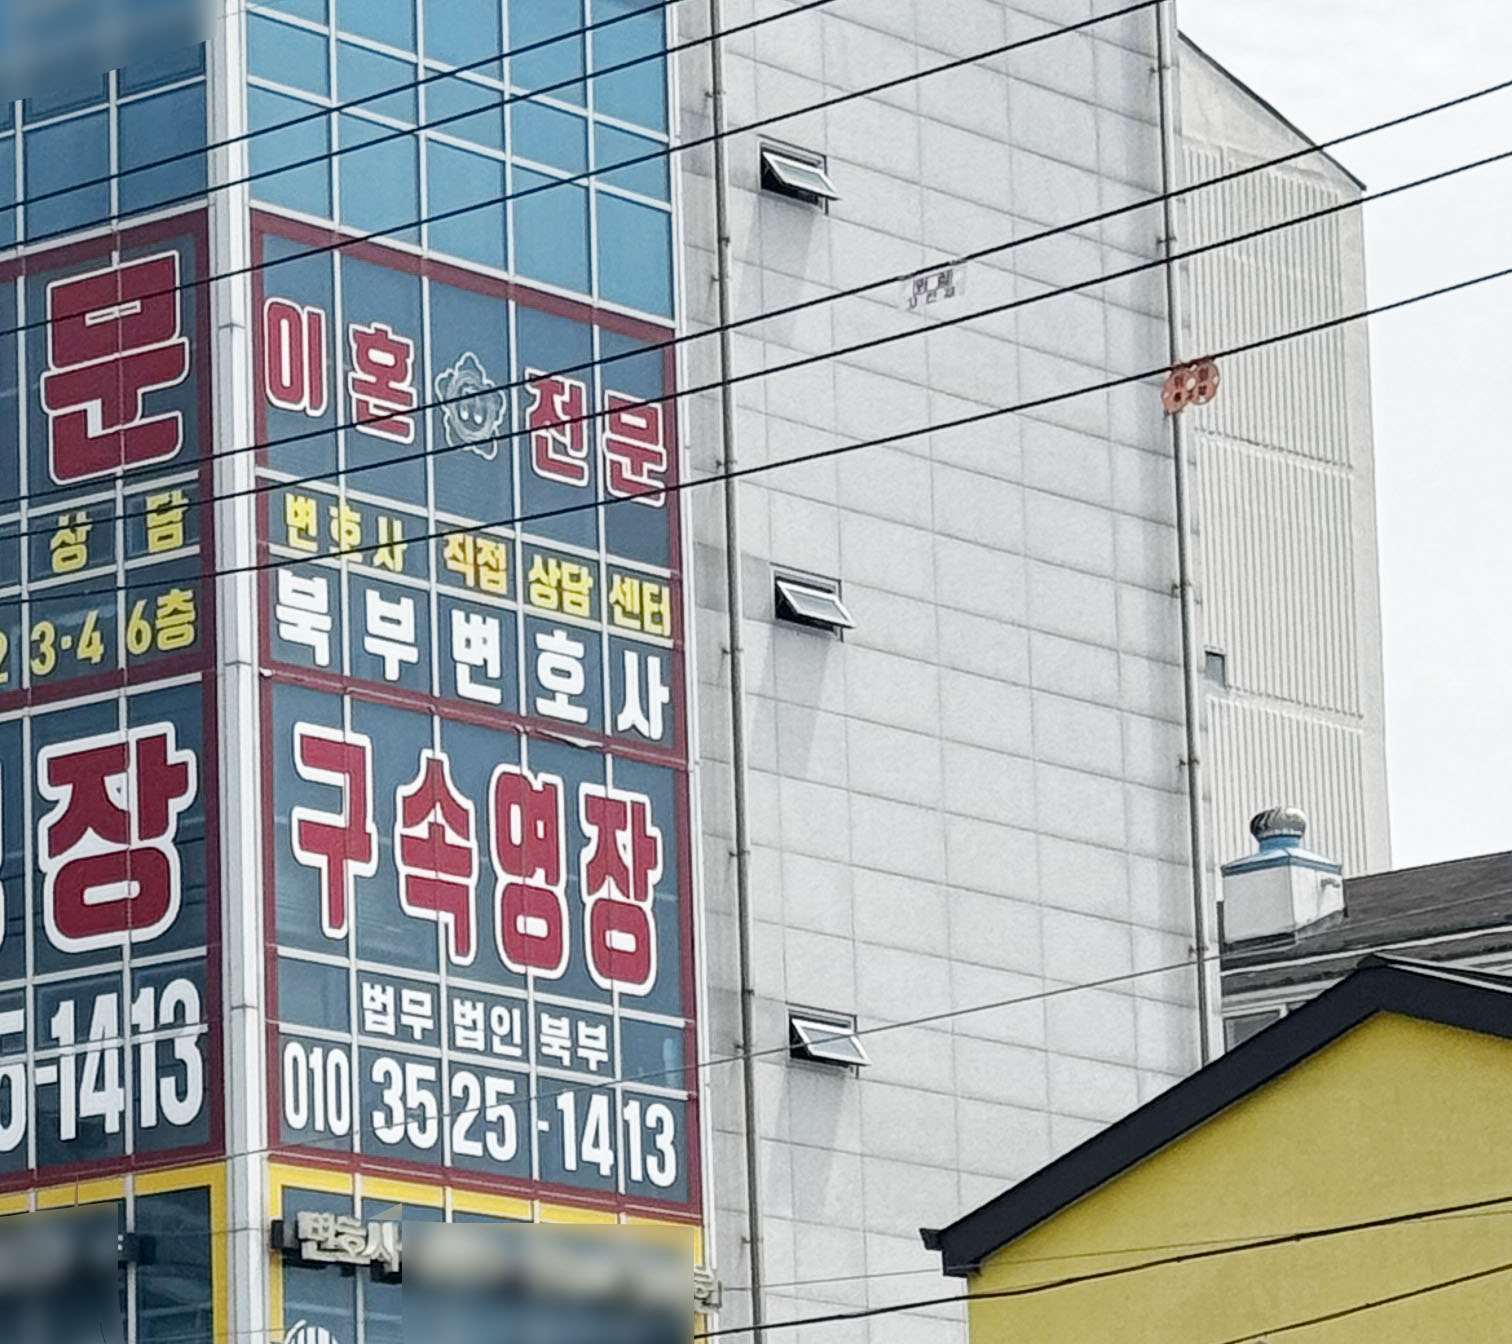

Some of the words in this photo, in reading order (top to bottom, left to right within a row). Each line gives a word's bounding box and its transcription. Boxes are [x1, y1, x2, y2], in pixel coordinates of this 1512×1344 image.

[263, 297, 418, 444] 이혼
[525, 366, 669, 507] 전문
[285, 492, 409, 574] 변호사
[442, 532, 509, 597] 직접
[290, 719, 664, 998] 구속영장
